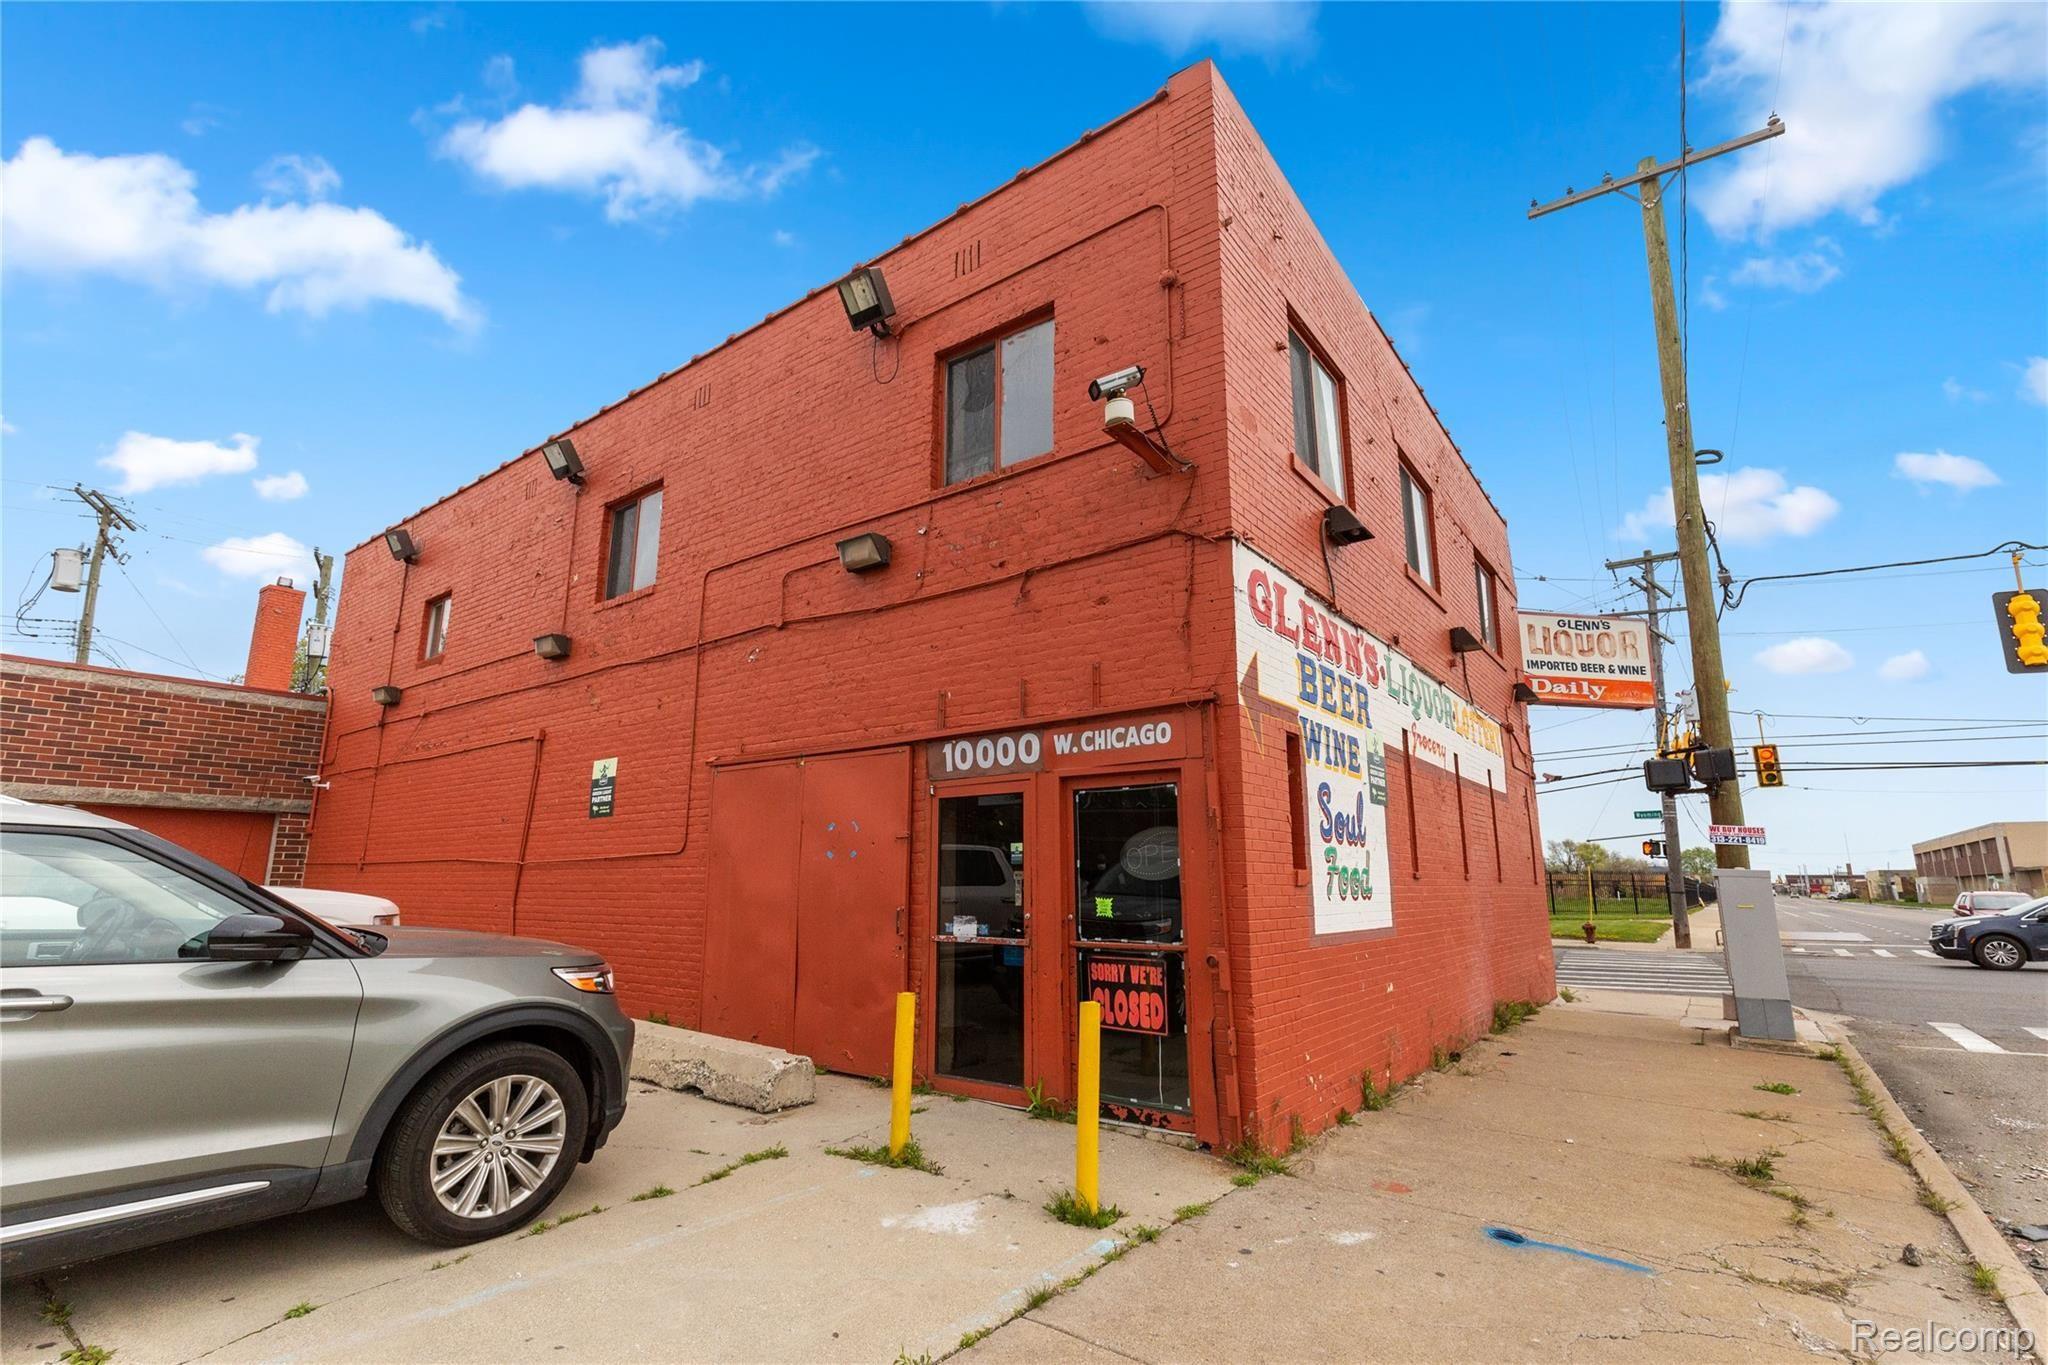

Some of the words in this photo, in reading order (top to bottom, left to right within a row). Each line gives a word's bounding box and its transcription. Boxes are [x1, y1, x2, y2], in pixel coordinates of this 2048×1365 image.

[1526, 623, 1640, 660] LIQUOR
[1557, 619, 1611, 631] GLENN'S
[1247, 568, 1380, 689] GLENN'S
[1384, 654, 1456, 732] LIQUOR
[1526, 660, 1578, 672] IMPORTED
[1580, 663, 1606, 674] BEER
[1608, 665, 1616, 674] &
[1617, 665, 1647, 676] WINE
[1294, 652, 1373, 730] BEER
[1529, 678, 1608, 700] Daily
[942, 732, 1040, 772] 10000
[1299, 716, 1362, 778] WINE
[1317, 782, 1367, 848] Soul
[1709, 825, 1720, 833] WE
[1324, 845, 1373, 902] Food
[1091, 962, 1126, 983] SORRY
[1130, 964, 1163, 987] WE'RE
[1093, 987, 1164, 1030] CLOSED
